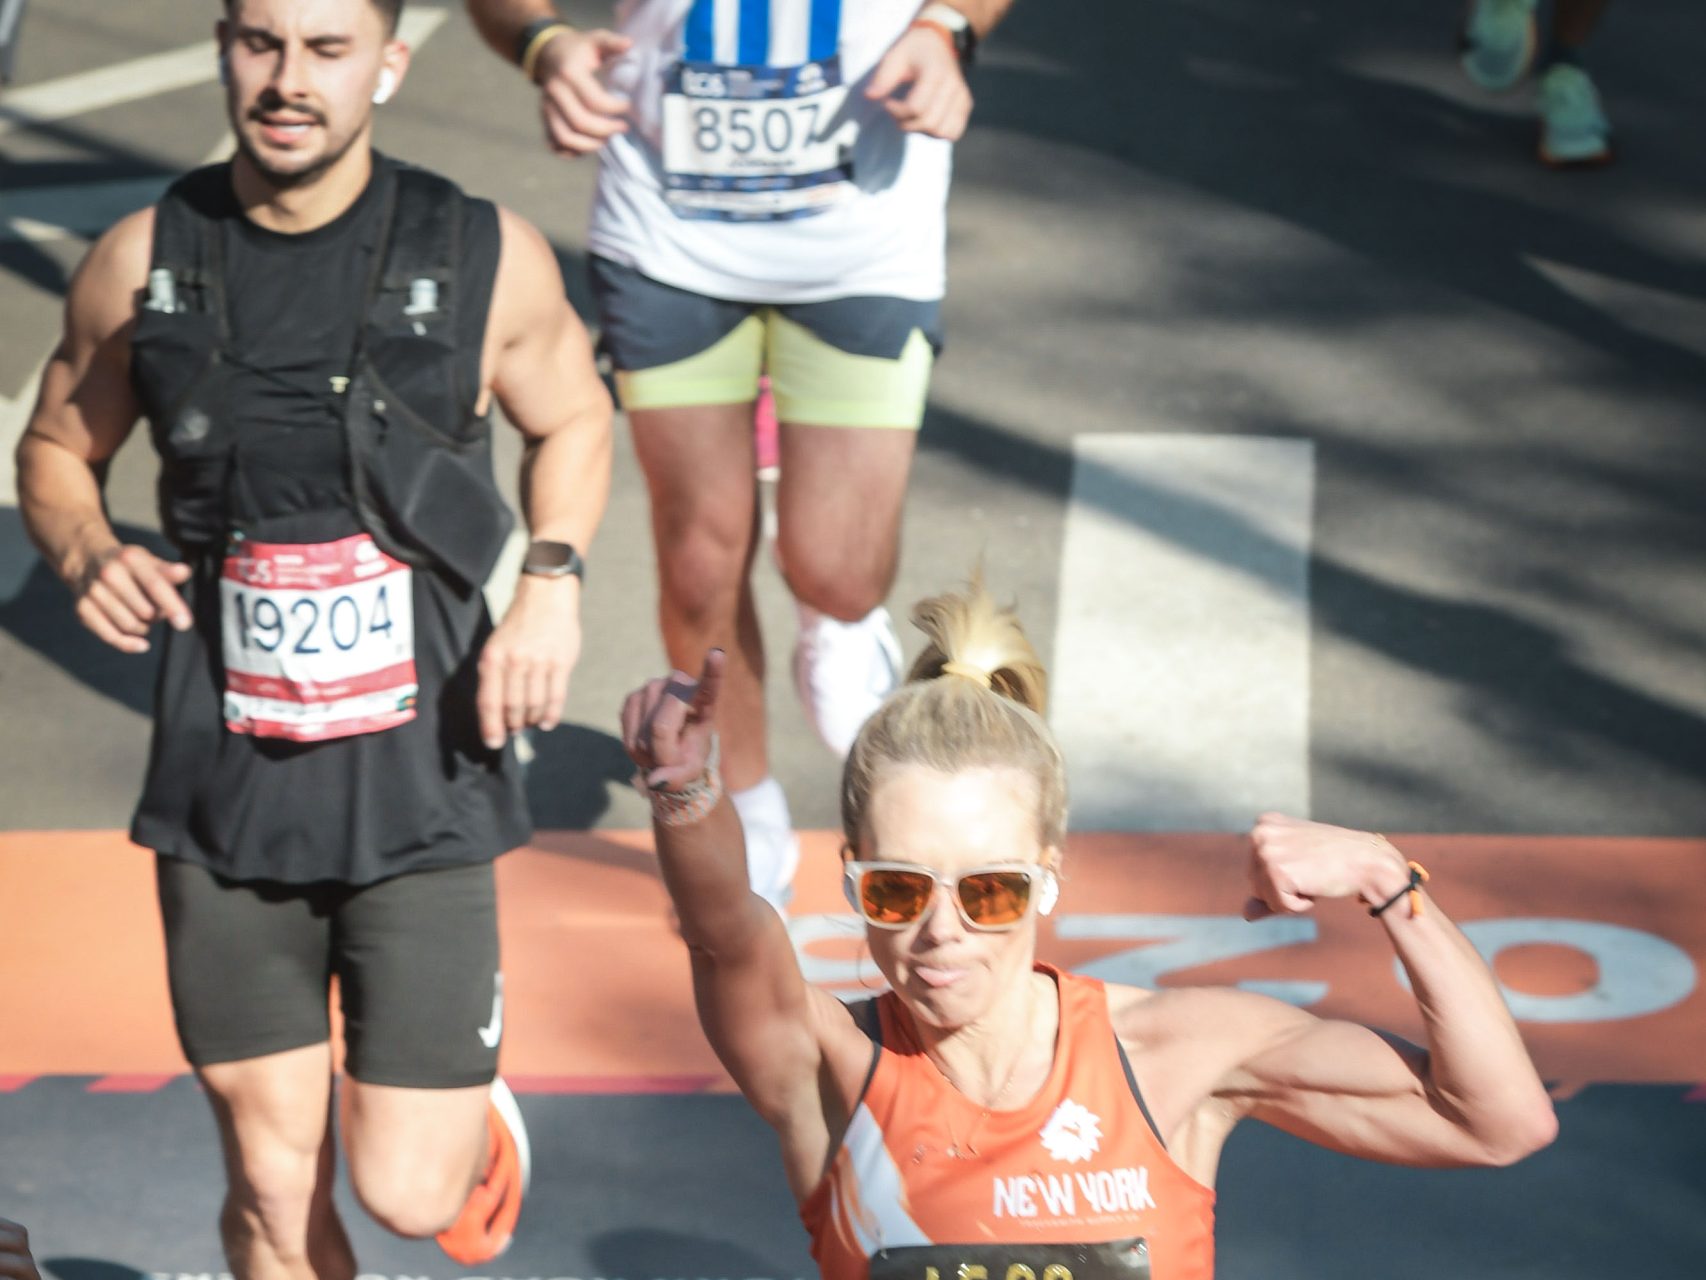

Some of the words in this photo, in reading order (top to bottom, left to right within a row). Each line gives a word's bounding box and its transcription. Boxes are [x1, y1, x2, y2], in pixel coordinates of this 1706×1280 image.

[235, 585, 392, 654] 19204
[993, 1173, 1076, 1218] NEW
[1075, 1166, 1156, 1214] YORK
